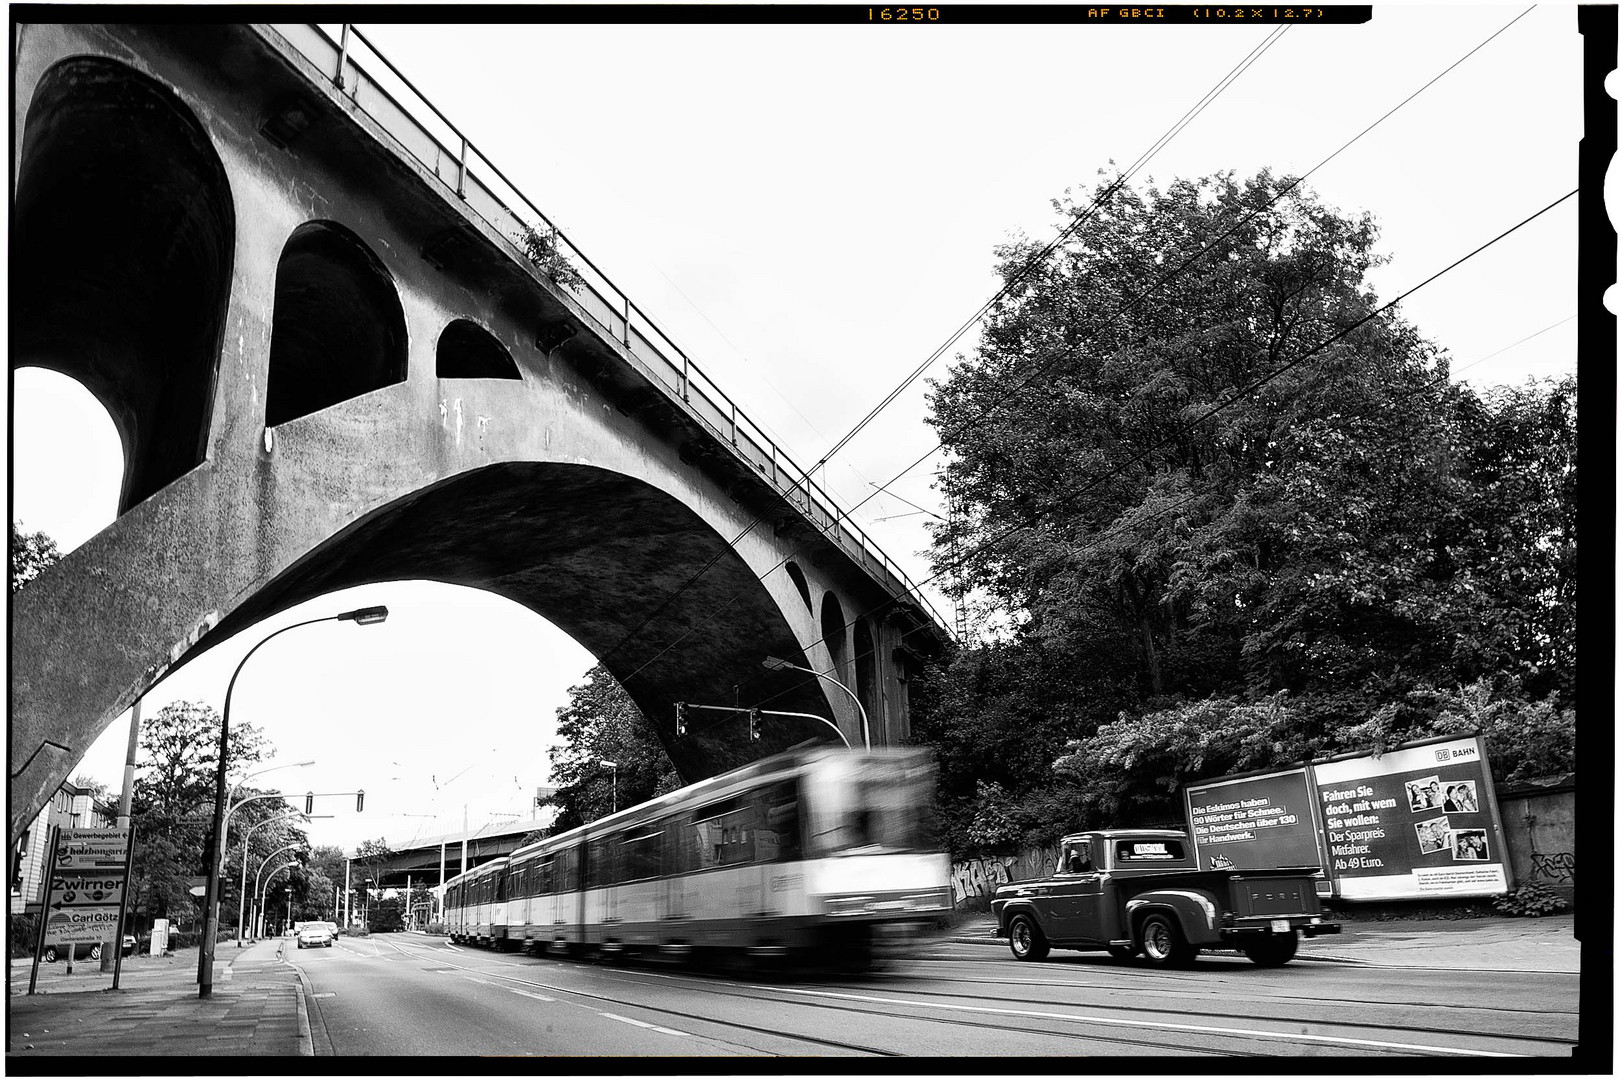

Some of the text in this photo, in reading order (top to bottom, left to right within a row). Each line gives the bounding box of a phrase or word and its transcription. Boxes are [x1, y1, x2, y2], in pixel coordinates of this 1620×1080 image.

[1436, 748, 1475, 760] DB BAHN
[1323, 785, 1373, 802] Fahren Sie
[1192, 798, 1268, 815] Die Eskimos haben
[1326, 798, 1396, 816] doch, mit wem
[1205, 813, 1233, 823] Wörter
[1234, 811, 1247, 819] für
[1248, 807, 1284, 817] Schnee.
[1196, 815, 1296, 835] Die Deutschen über 130
[1328, 815, 1379, 829] Sie wollen:
[73, 831, 121, 840] Gewerbegebiet
[1209, 831, 1255, 842] Handwerk.
[1330, 827, 1385, 843] Der Sparpreis
[1332, 844, 1371, 856] Mitfahrer.
[1335, 857, 1384, 870] Ab 49 Euro.
[51, 878, 124, 890] Zwirner
[72, 912, 119, 922] Carl Götz
